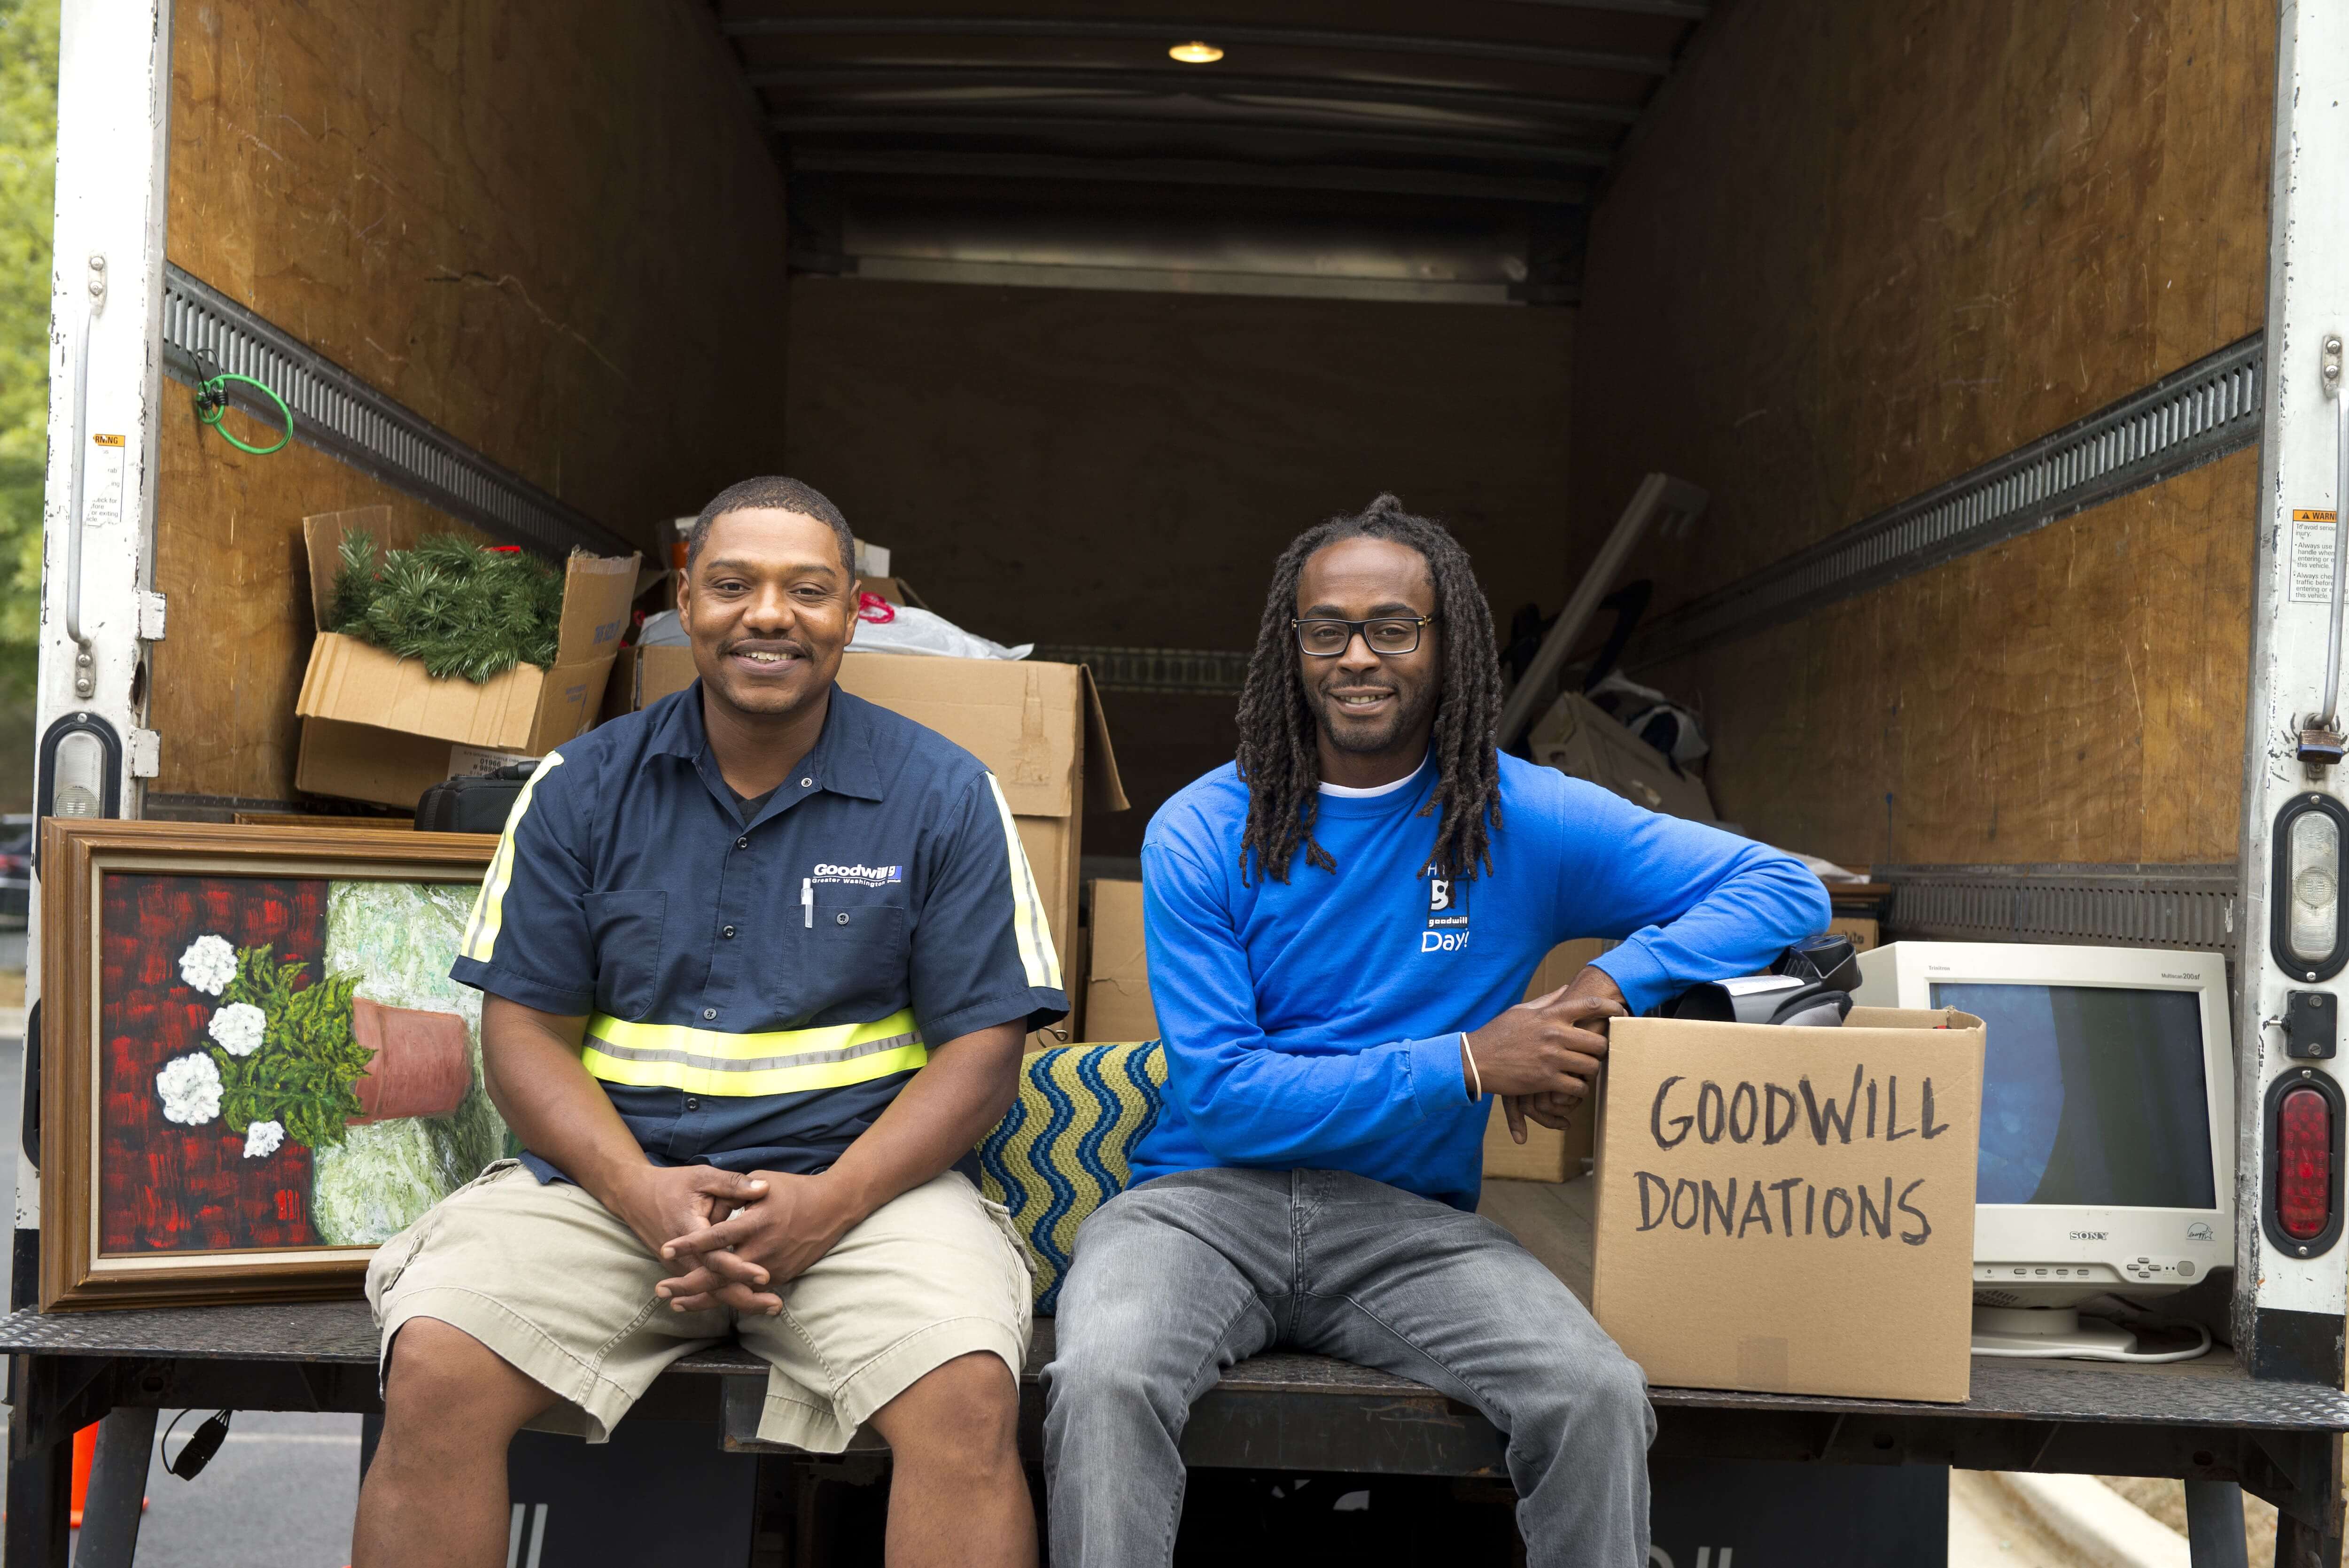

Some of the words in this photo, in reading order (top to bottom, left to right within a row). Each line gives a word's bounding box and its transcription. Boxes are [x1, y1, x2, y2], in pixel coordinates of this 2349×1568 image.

[814, 863, 888, 879] Goodwill
[843, 878, 886, 888] Washington
[1429, 916, 1468, 927] goodwill
[1421, 931, 1470, 953] Day!
[1650, 1063, 1950, 1151] GOODWILL
[1633, 1171, 1932, 1246] DONATIONS
[2069, 1231, 2109, 1240] SONY
